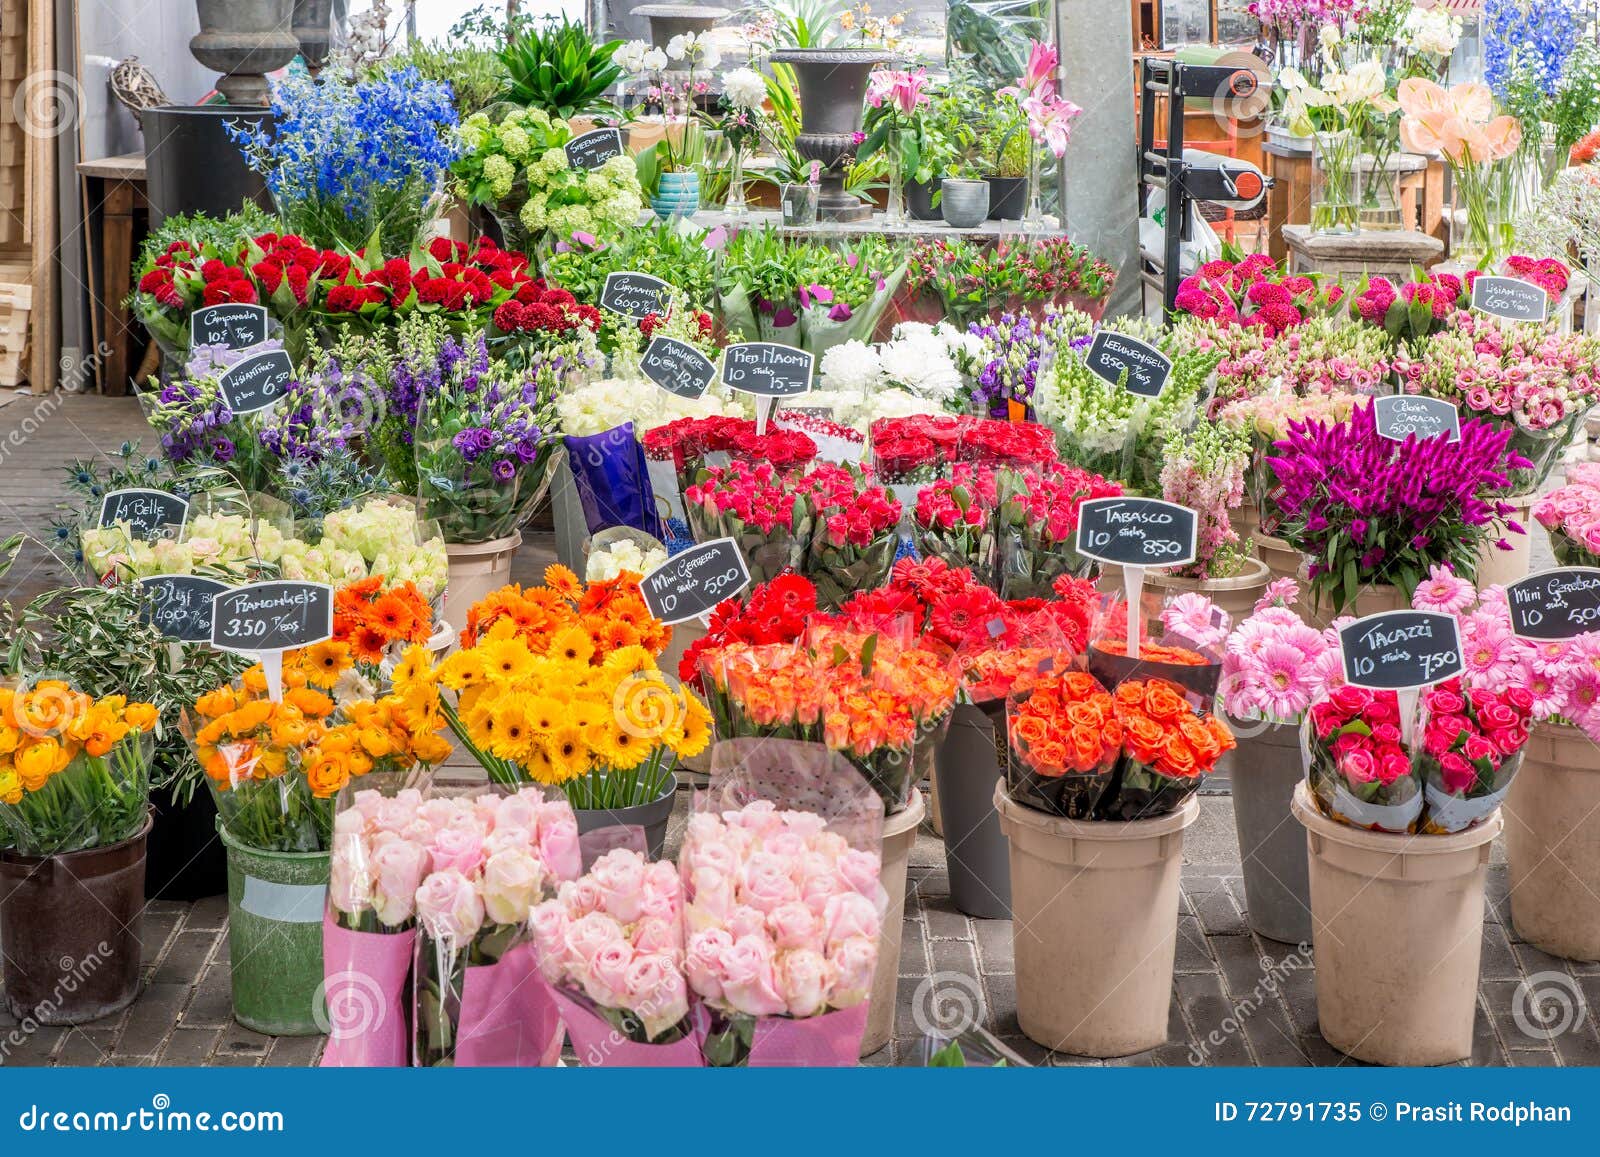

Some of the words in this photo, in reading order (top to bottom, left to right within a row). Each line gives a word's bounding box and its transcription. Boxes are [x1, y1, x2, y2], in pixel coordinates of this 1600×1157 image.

[572, 156, 584, 166] 10
[647, 353, 660, 366] 10
[728, 367, 746, 381] 10
[1094, 502, 1173, 525] TABASCO
[1087, 529, 1111, 548] 10
[650, 570, 677, 594] Mini
[659, 594, 677, 614] 10
[1513, 586, 1541, 604] Mini
[223, 618, 267, 637] 3.50
[1521, 609, 1543, 627] 10
[1353, 656, 1375, 677] 10
[1418, 650, 1458, 680] 7.50
